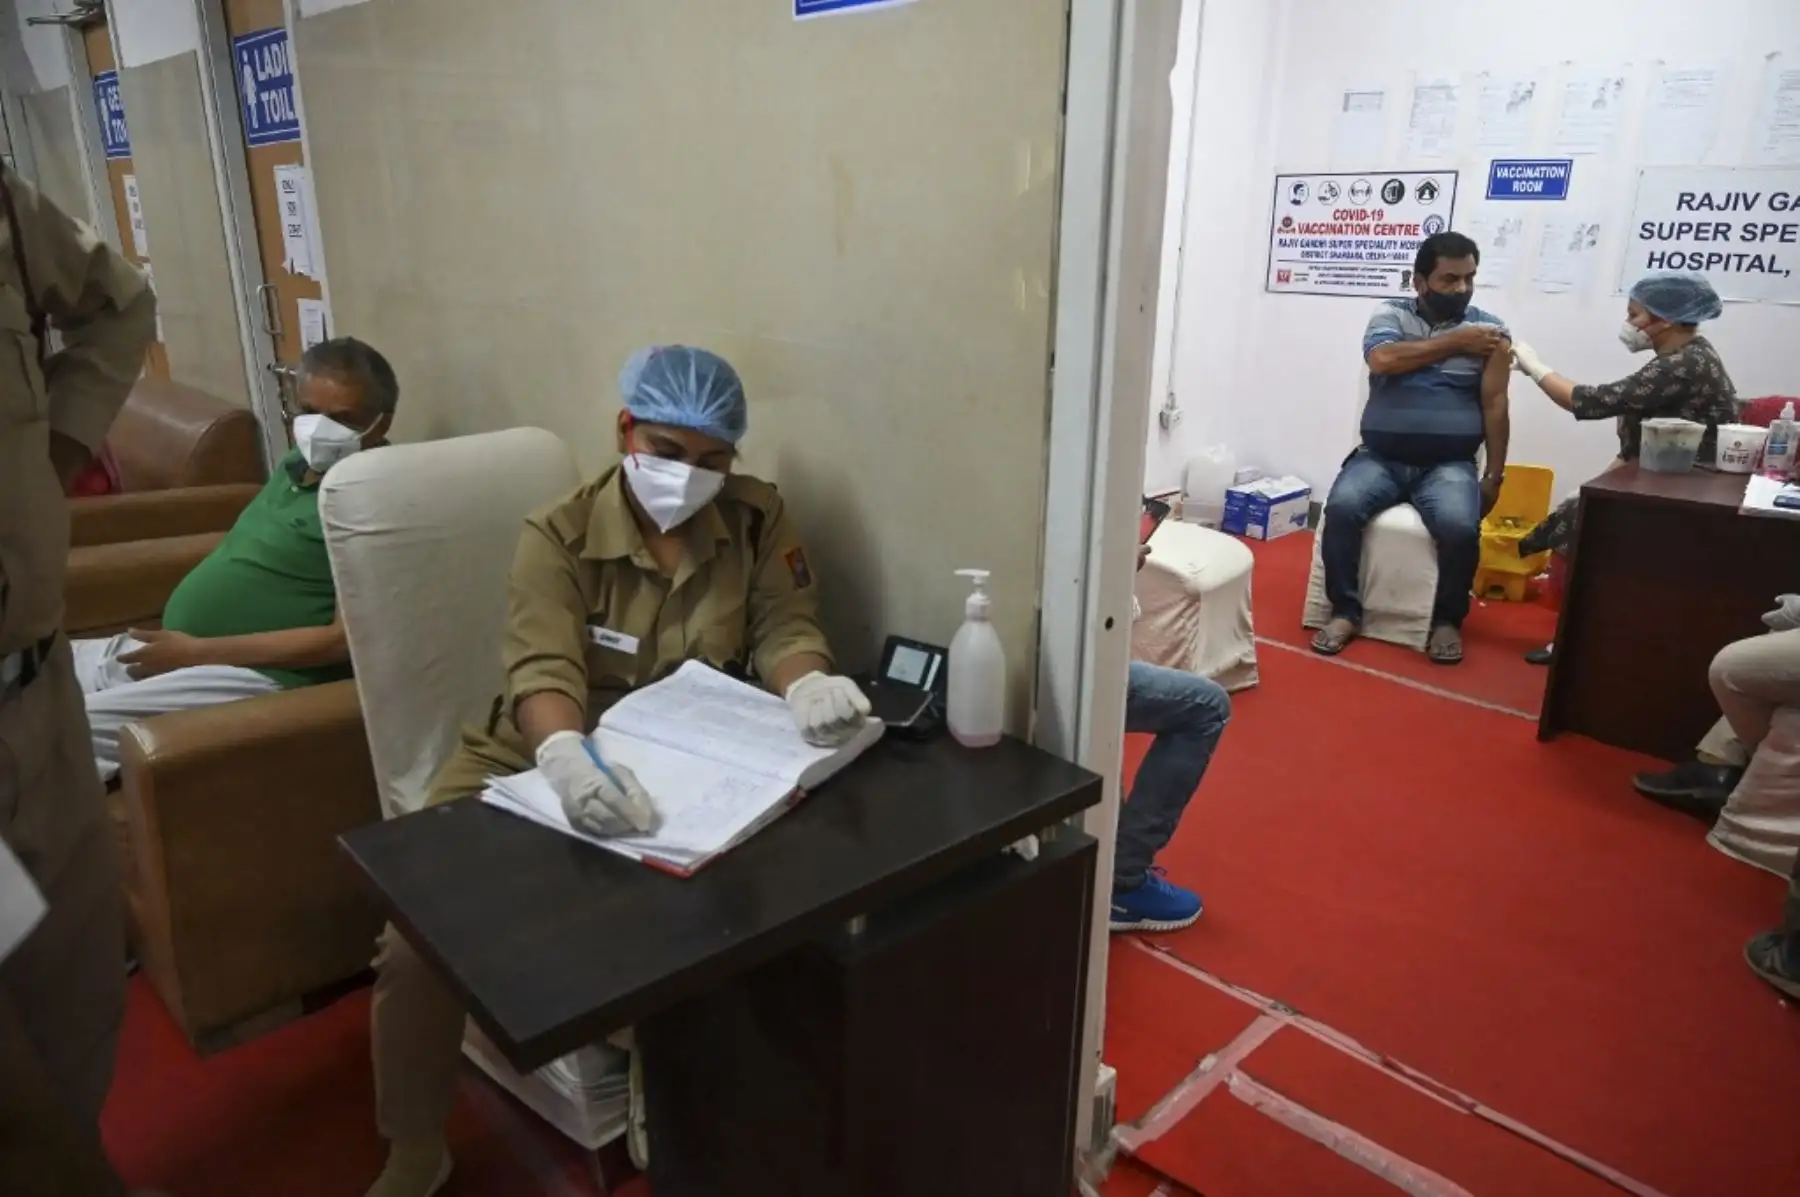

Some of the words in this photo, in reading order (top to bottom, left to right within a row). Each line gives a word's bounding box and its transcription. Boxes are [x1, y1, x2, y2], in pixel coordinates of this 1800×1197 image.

[1496, 166, 1566, 179] VACCINATION
[1512, 180, 1544, 193] ROOM
[1676, 191, 1760, 212] RAJIV
[1333, 208, 1384, 222] COVID-19
[1298, 222, 1370, 236] VACCINATION
[1372, 223, 1420, 237] CENTRE
[1639, 221, 1732, 242] SUPER
[1646, 251, 1791, 278] HOSPITAL,
